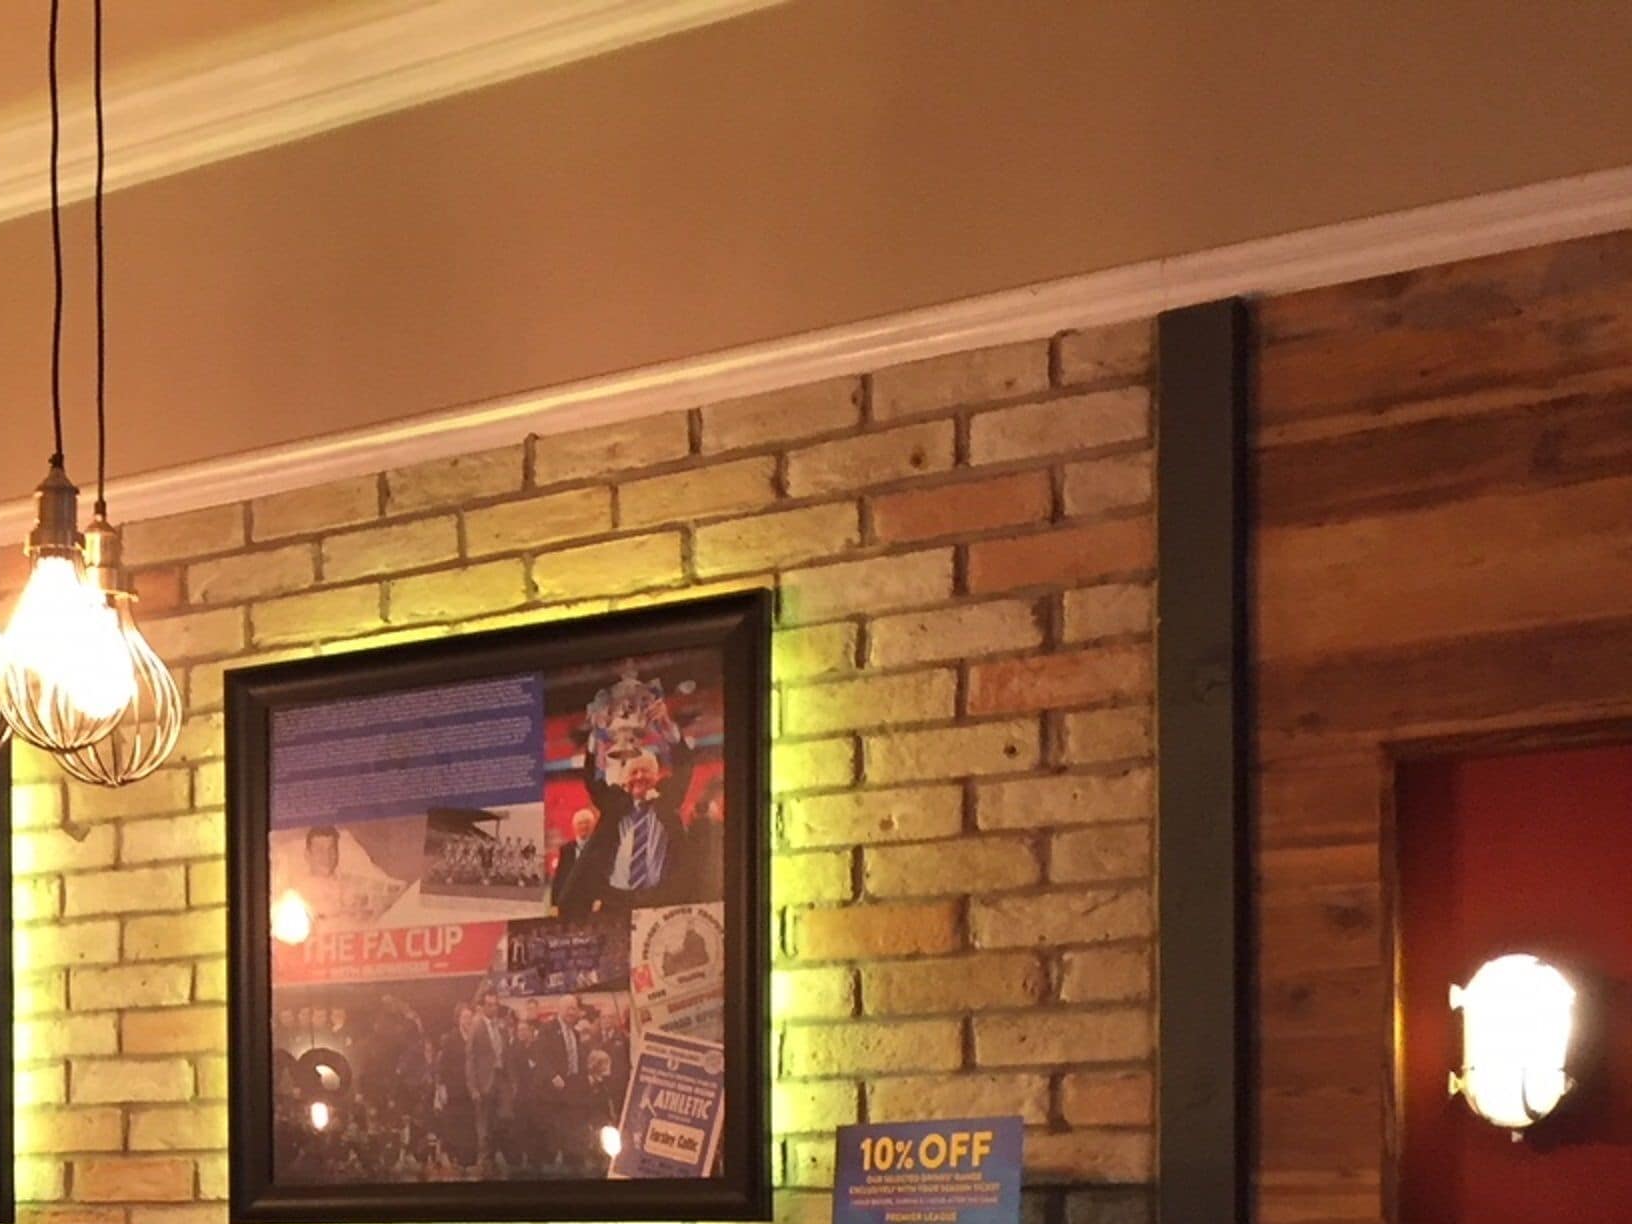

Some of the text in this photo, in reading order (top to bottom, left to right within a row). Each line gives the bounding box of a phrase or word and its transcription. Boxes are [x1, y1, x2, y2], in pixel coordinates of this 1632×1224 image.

[303, 926, 464, 965] THE FA CUP
[653, 1088, 713, 1121] ATHLETIC
[860, 1130, 994, 1172] 10% OFF
